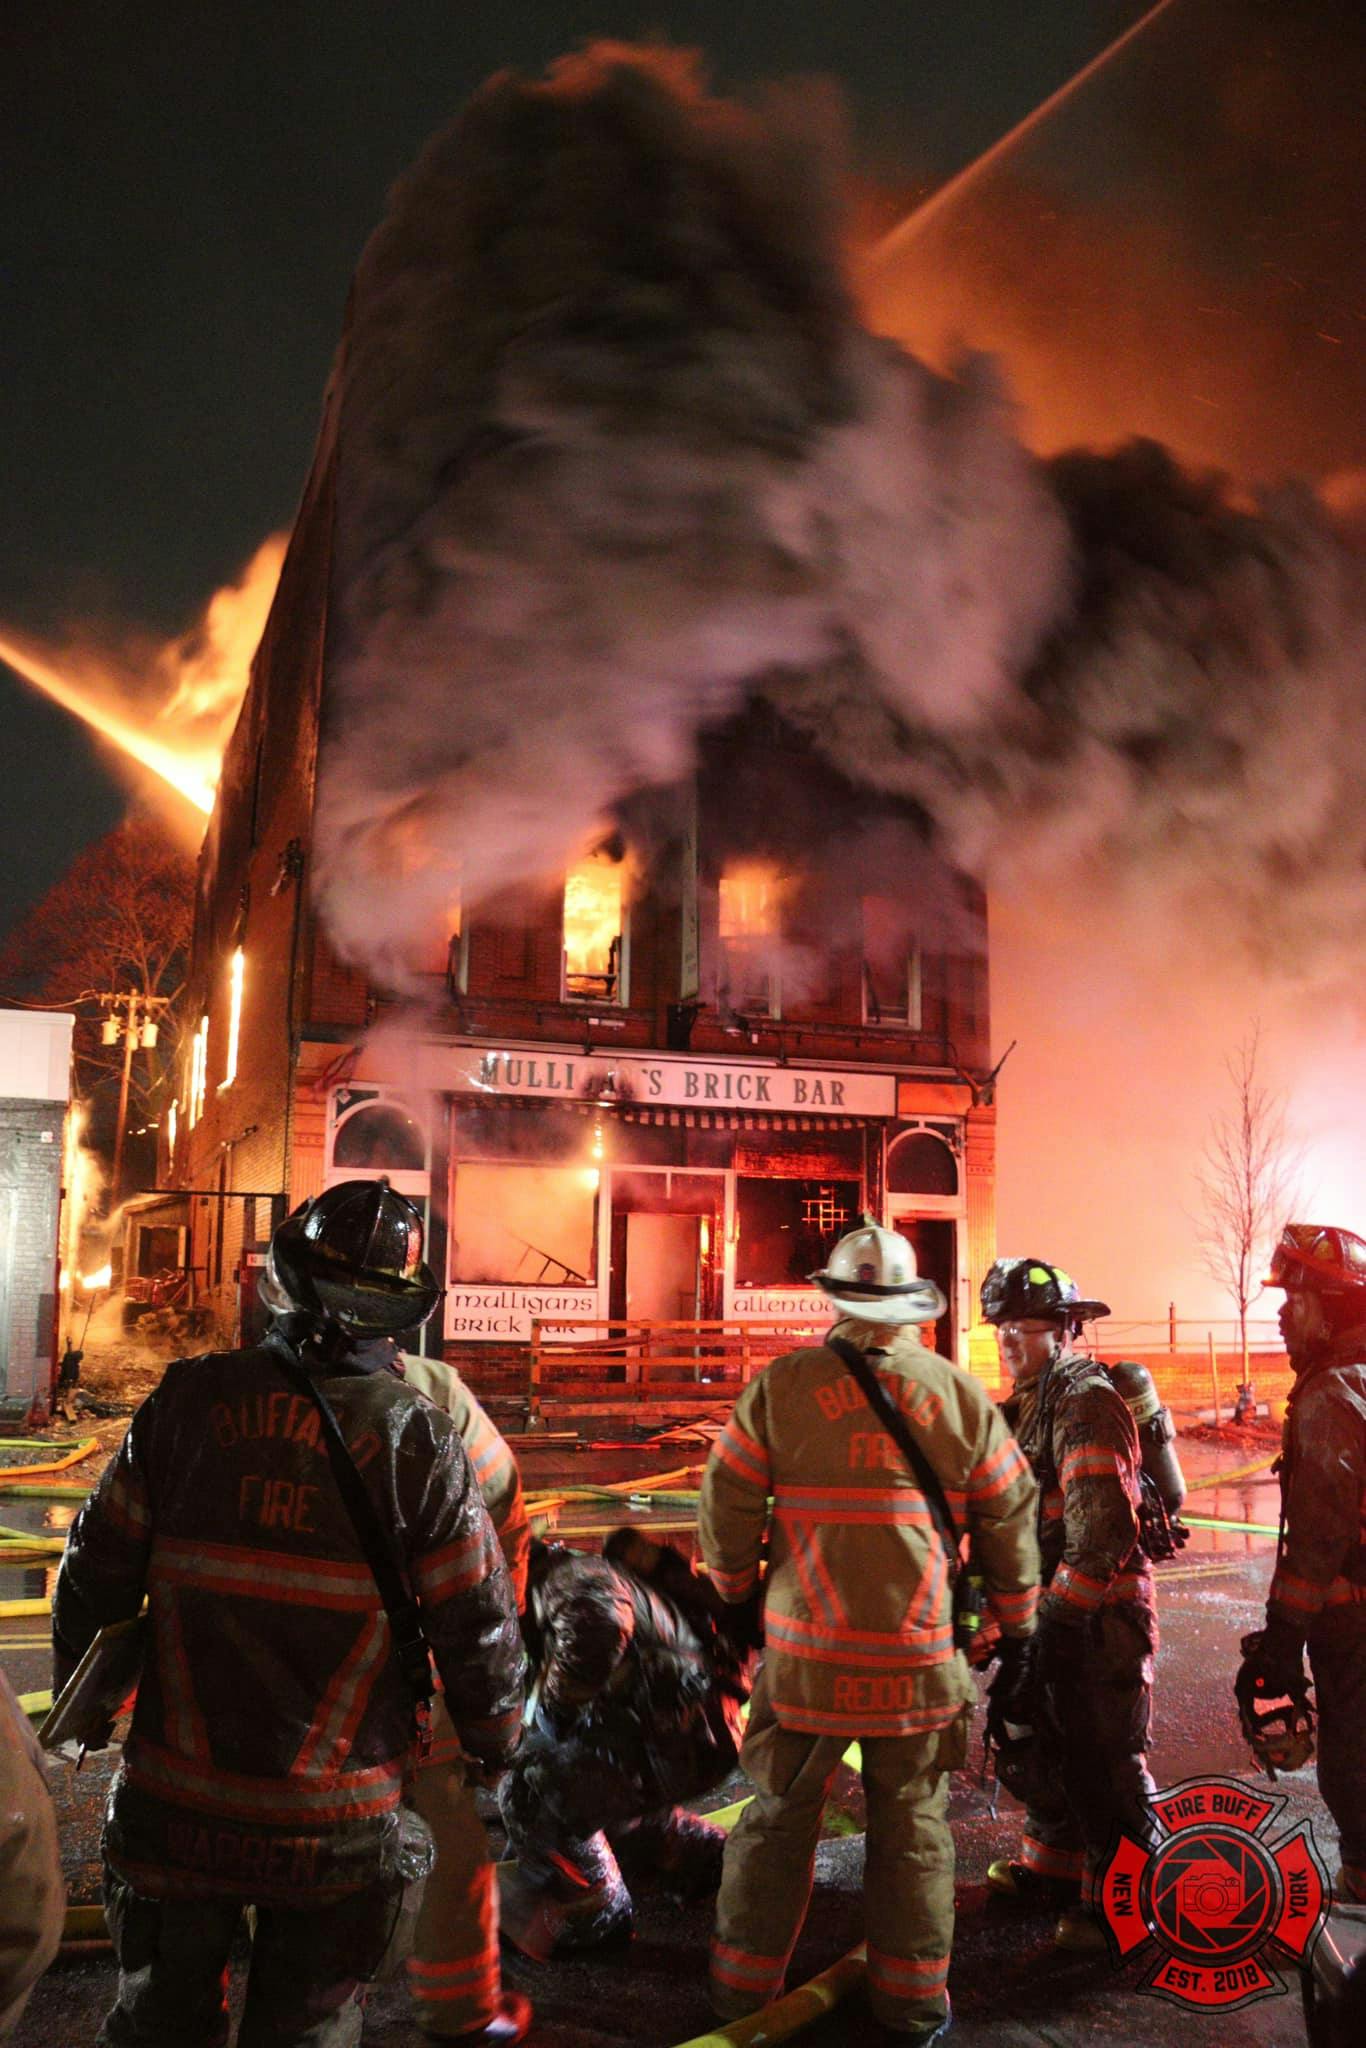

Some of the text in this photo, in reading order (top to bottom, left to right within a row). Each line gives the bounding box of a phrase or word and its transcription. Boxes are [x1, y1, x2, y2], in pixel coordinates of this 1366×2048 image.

[684, 1071, 772, 1102] BRICK
[793, 1077, 846, 1106] BAR
[239, 1473, 320, 1535] FIRE
